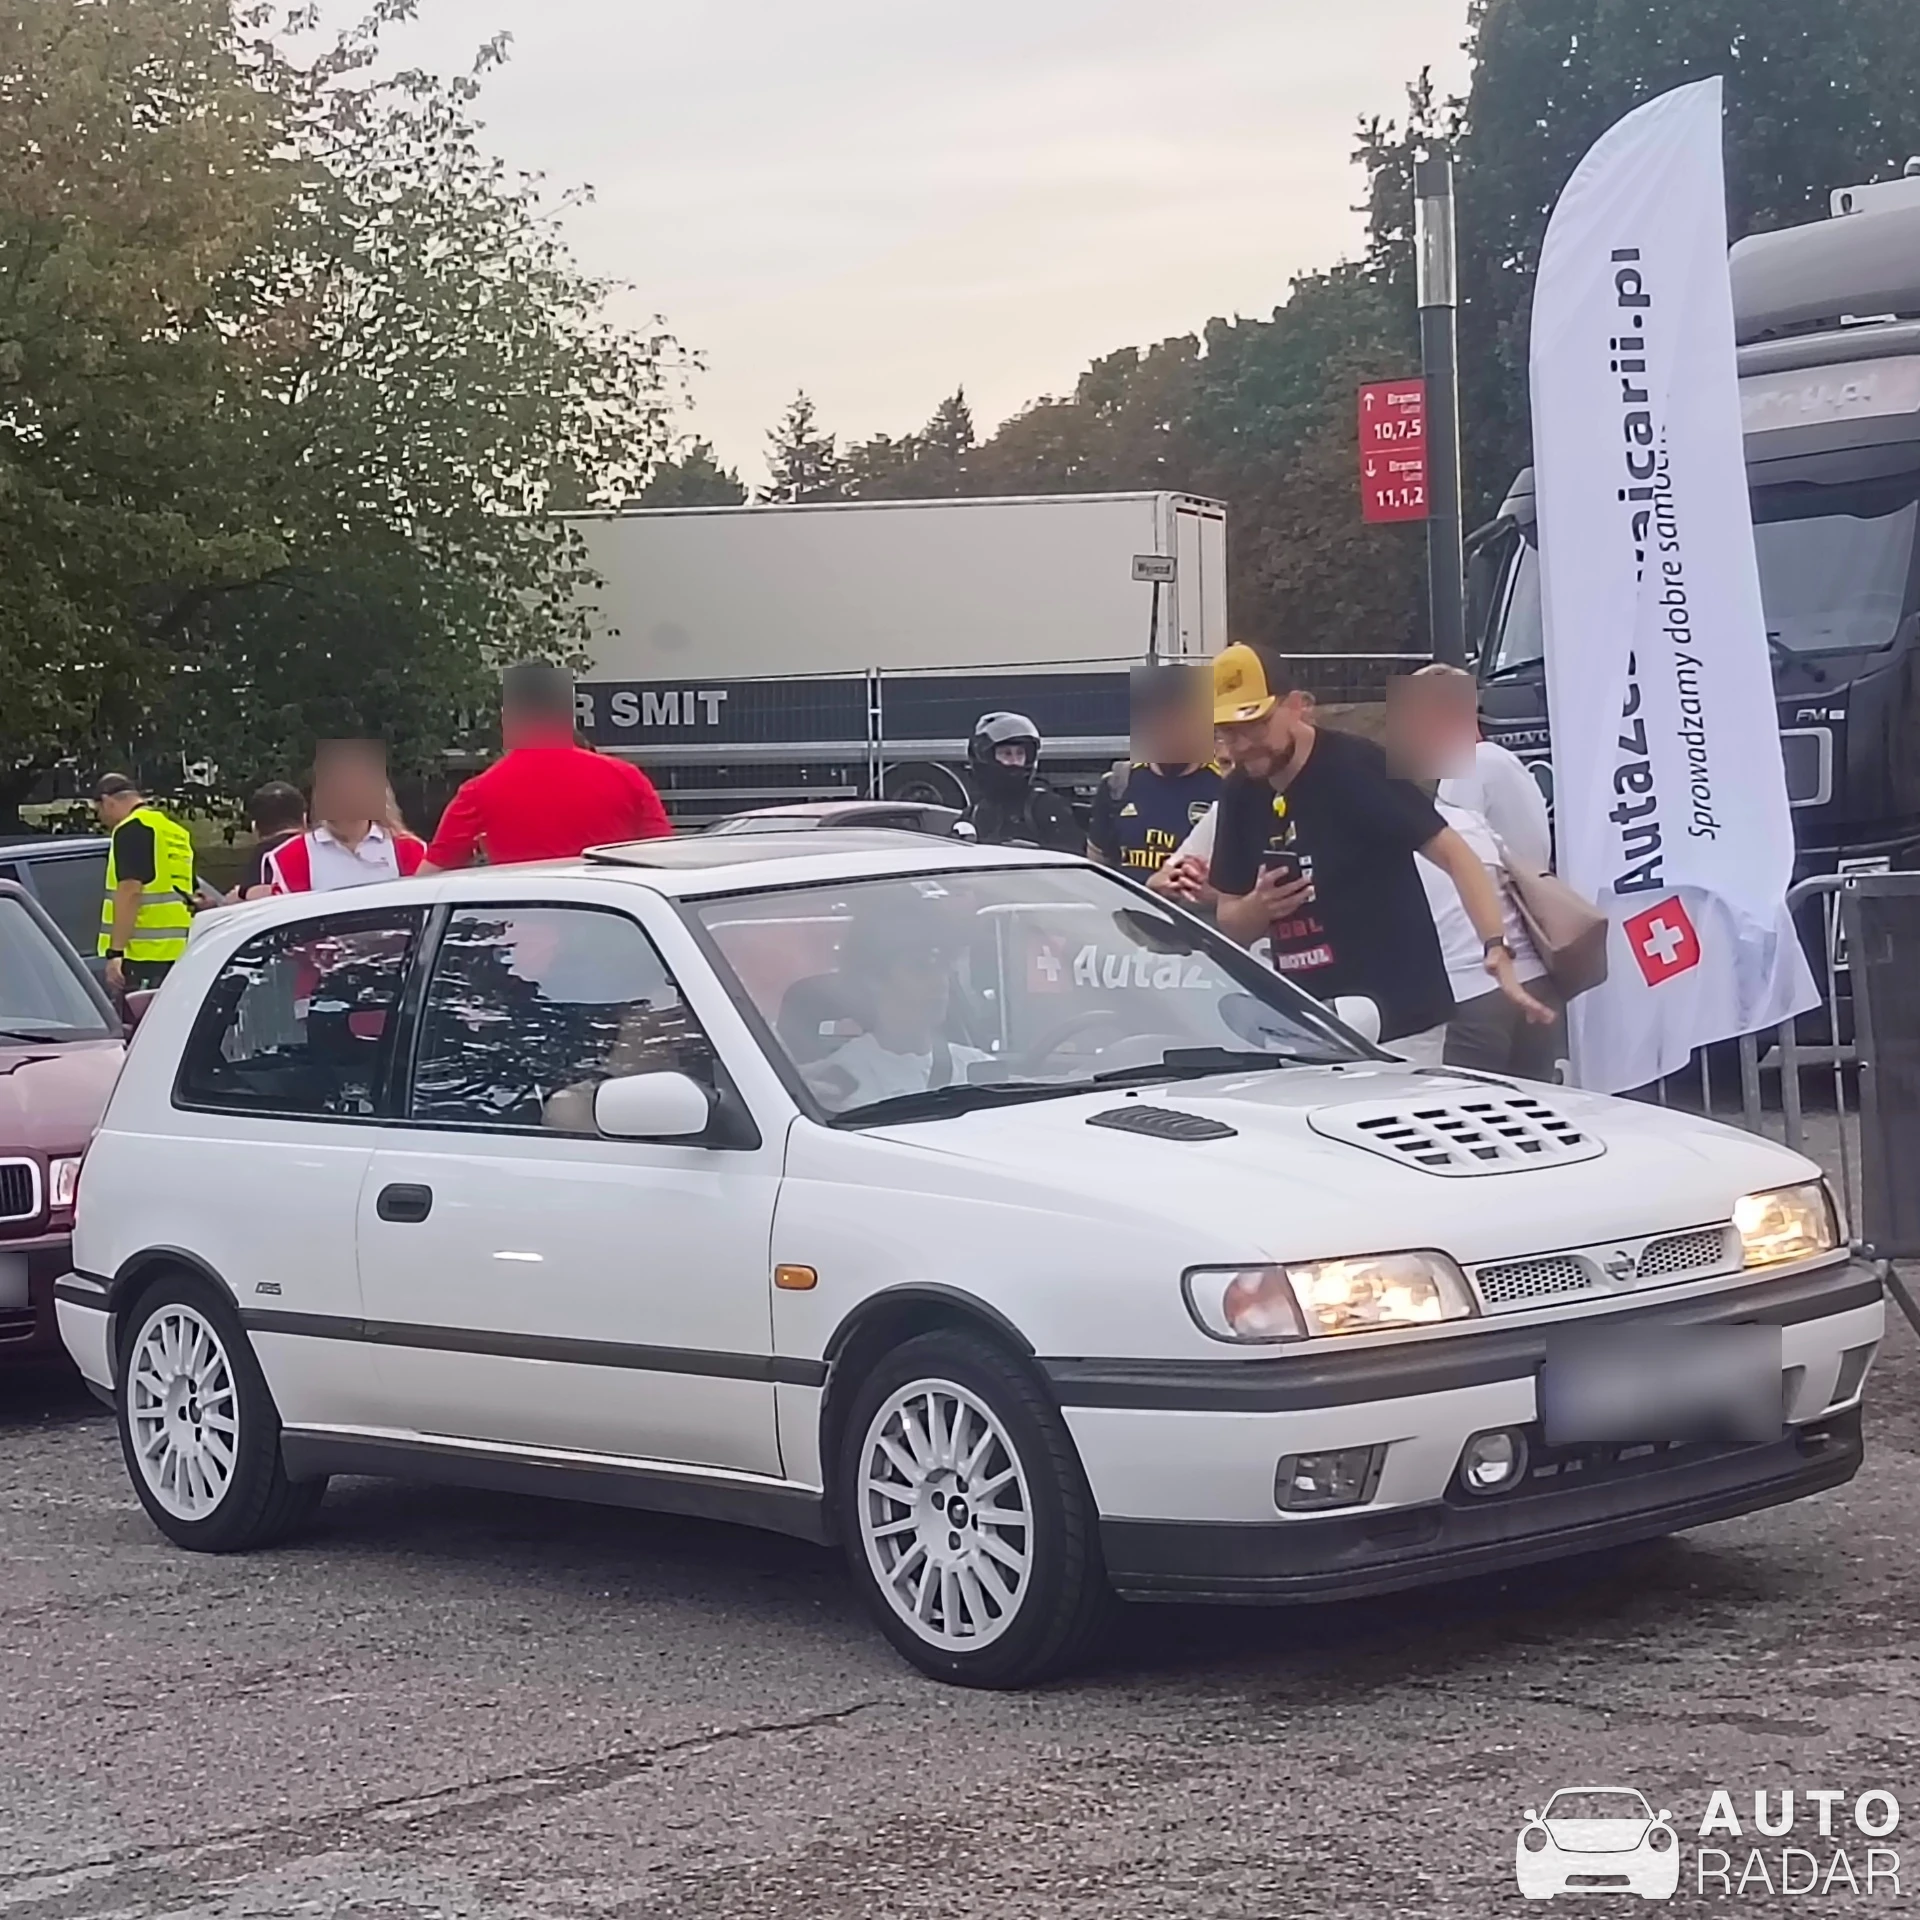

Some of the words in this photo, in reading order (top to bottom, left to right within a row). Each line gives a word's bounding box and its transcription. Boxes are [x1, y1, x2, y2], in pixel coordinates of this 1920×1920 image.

[1374, 419, 1422, 440] 10,7,5
[1376, 486, 1424, 508] 11,1,2
[1658, 561, 1692, 645] dobre
[574, 693, 595, 727] R
[610, 690, 728, 727] SMIT
[1674, 651, 1721, 840] Sprowadzamy
[1072, 944, 1226, 990] Autaz
